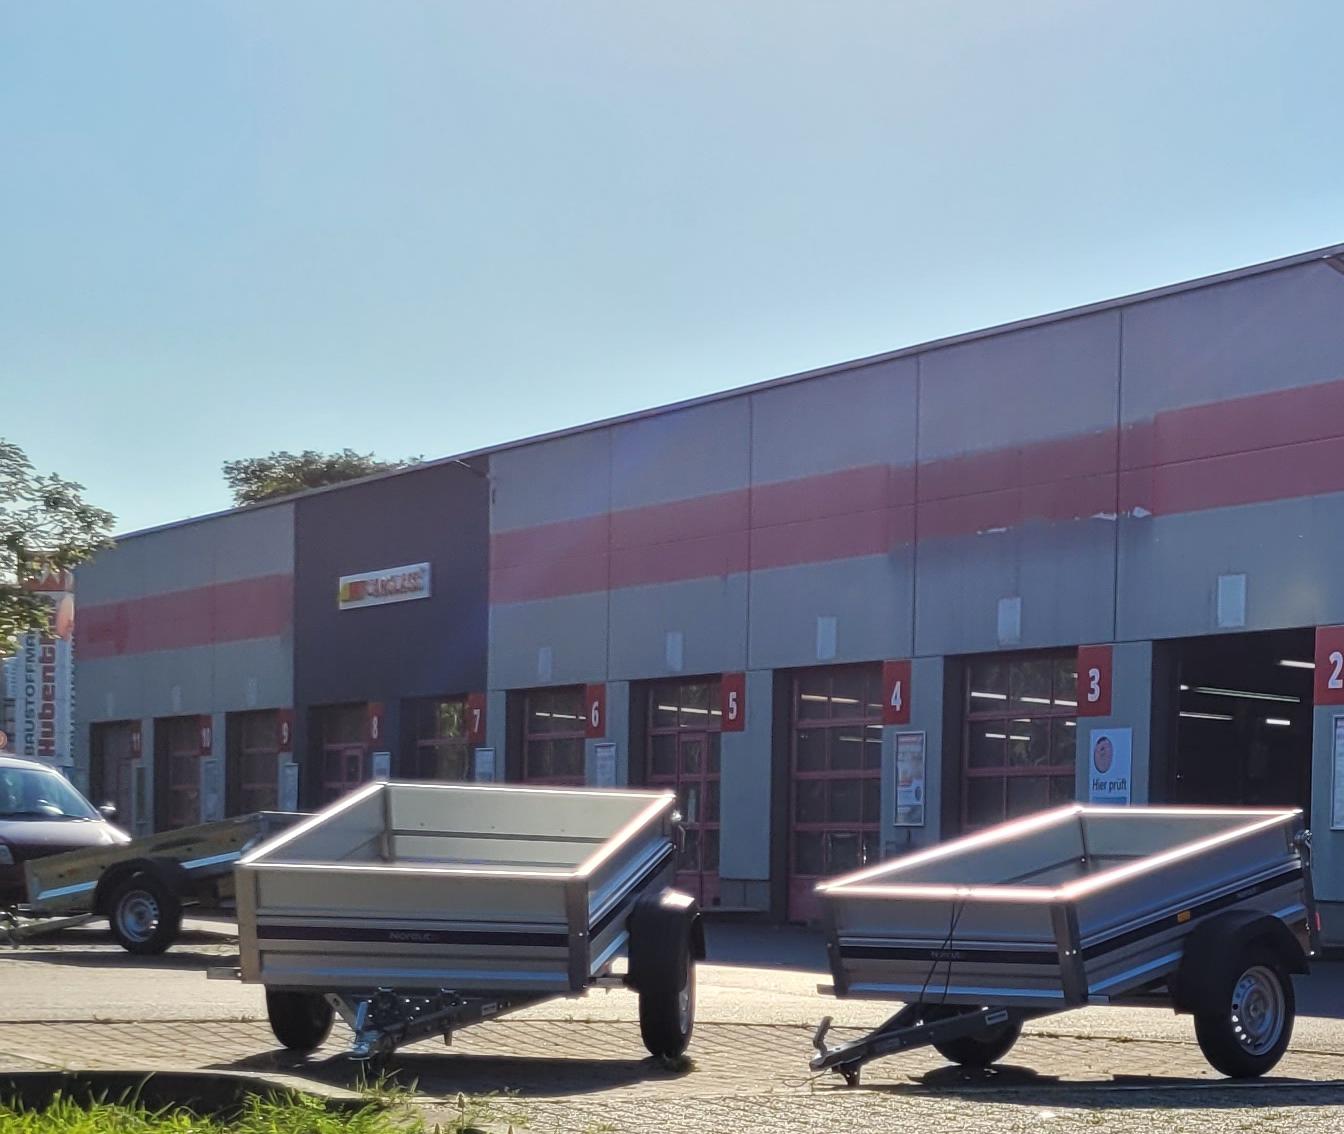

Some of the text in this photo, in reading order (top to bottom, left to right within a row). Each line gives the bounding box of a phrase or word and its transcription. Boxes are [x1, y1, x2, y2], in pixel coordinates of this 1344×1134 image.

[1328, 652, 1344, 689] 2
[24, 634, 36, 756] BAUSTOFFMA
[891, 681, 902, 712] 4
[1087, 668, 1100, 702] 3
[591, 702, 599, 727] 6
[728, 691, 737, 720] 5
[281, 722, 289, 744] 9
[371, 716, 378, 739] 8
[473, 709, 481, 733] 7
[1092, 778, 1127, 792] Hier prüft
